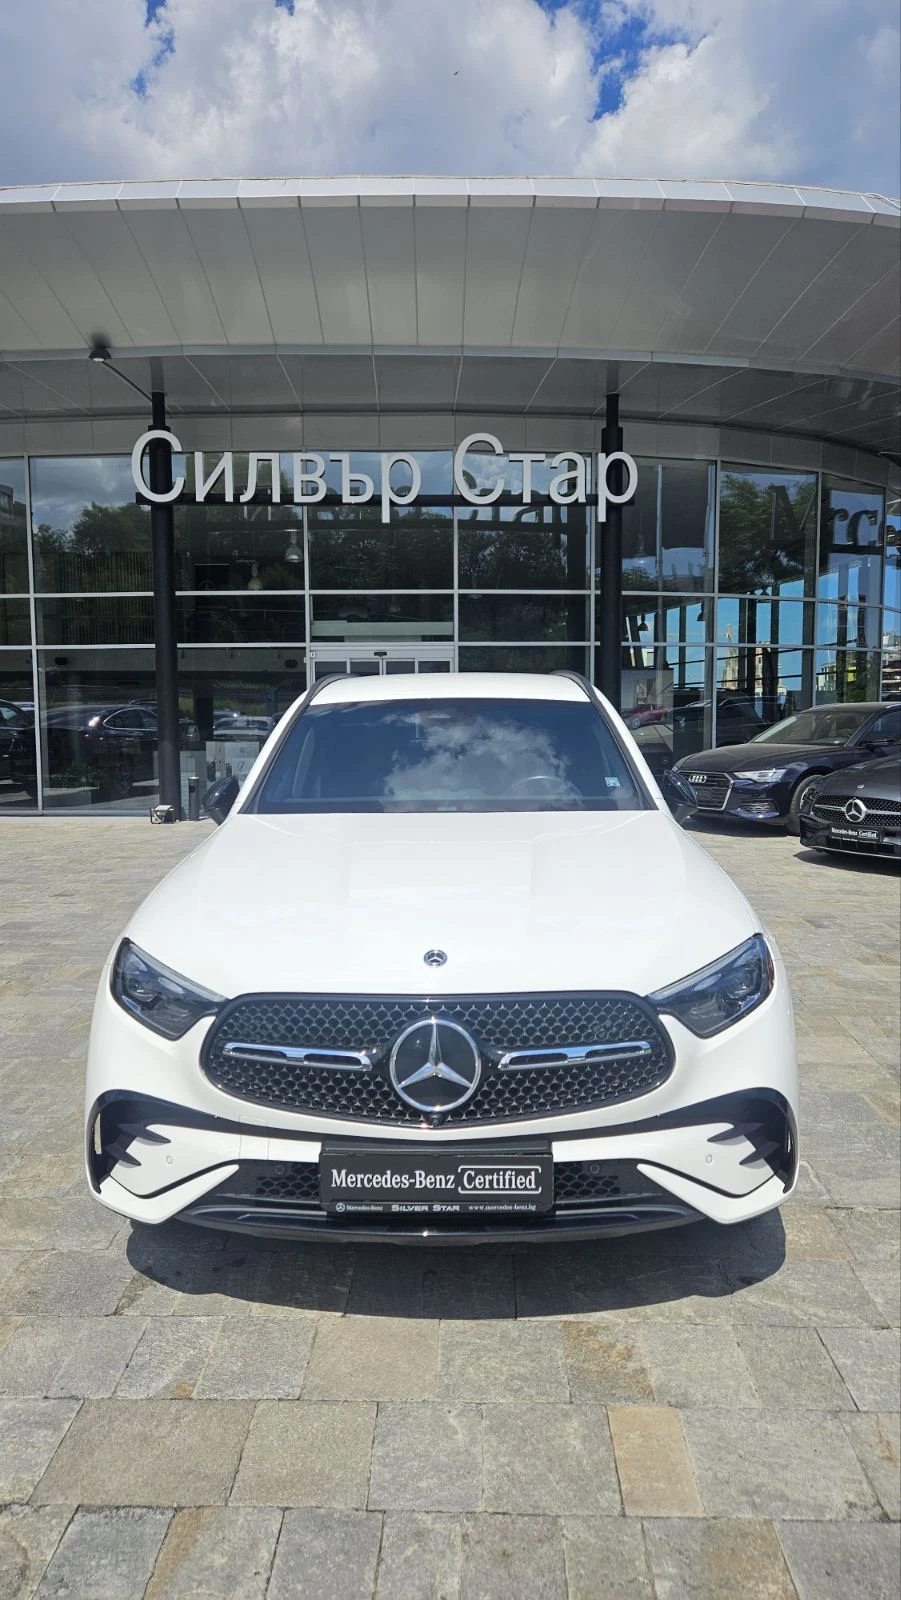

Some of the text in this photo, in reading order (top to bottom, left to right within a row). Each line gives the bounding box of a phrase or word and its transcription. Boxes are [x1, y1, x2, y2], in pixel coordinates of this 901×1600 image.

[131, 430, 422, 523] Силвър
[454, 432, 638, 522] Стар
[331, 1169, 536, 1189] Mercedes-Benz Certified
[391, 1204, 428, 1212] SILVER
[432, 1204, 460, 1212] STAR
